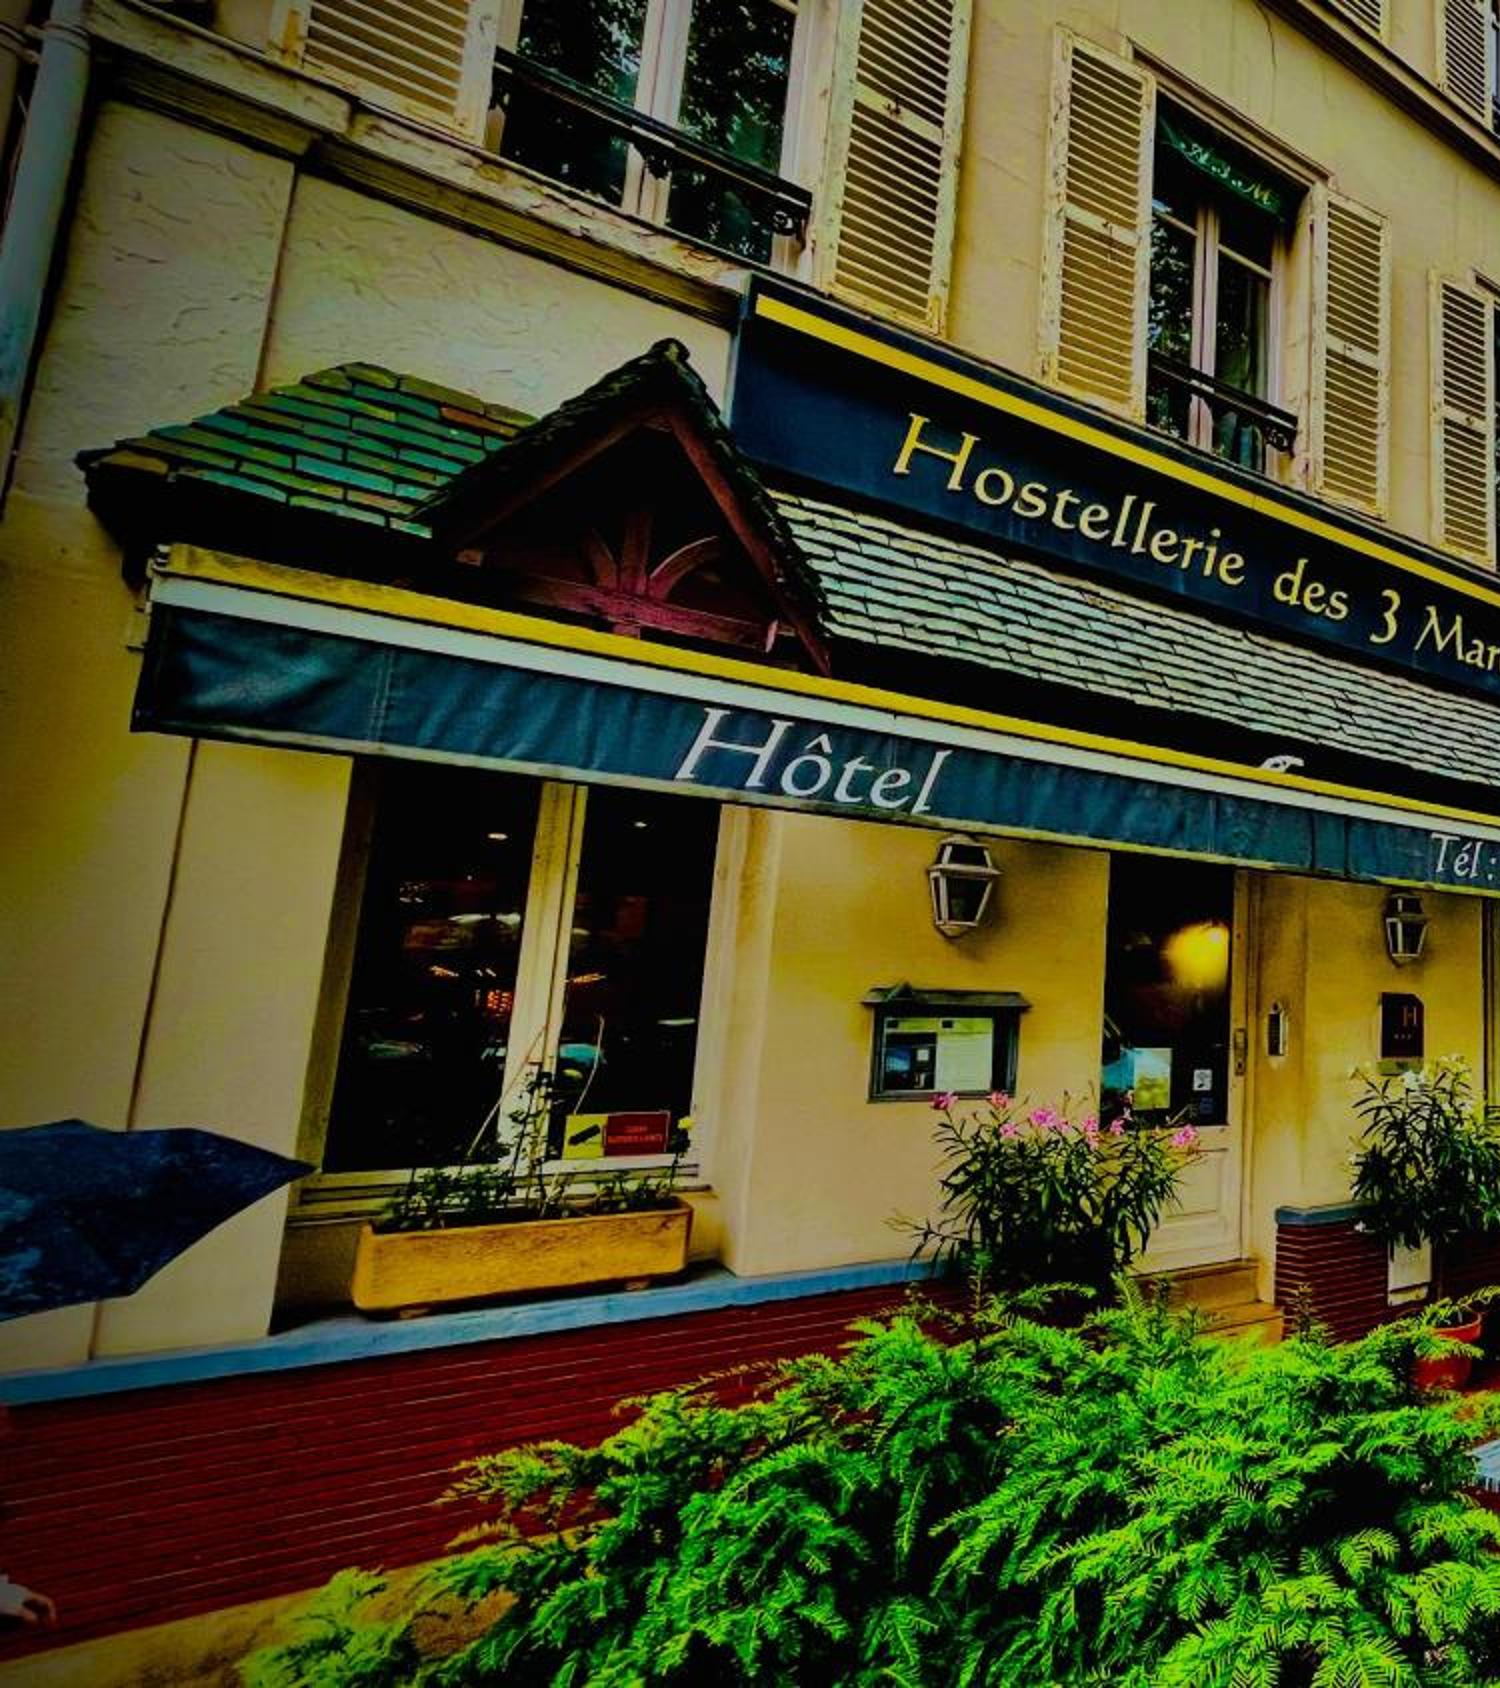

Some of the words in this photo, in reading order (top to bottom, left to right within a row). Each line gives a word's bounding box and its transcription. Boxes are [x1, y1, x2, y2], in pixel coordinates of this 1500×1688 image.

[892, 412, 1245, 586] Hostellerie
[1272, 558, 1349, 620] des
[1369, 589, 1401, 644] 3
[673, 707, 953, 815] Hôtel
